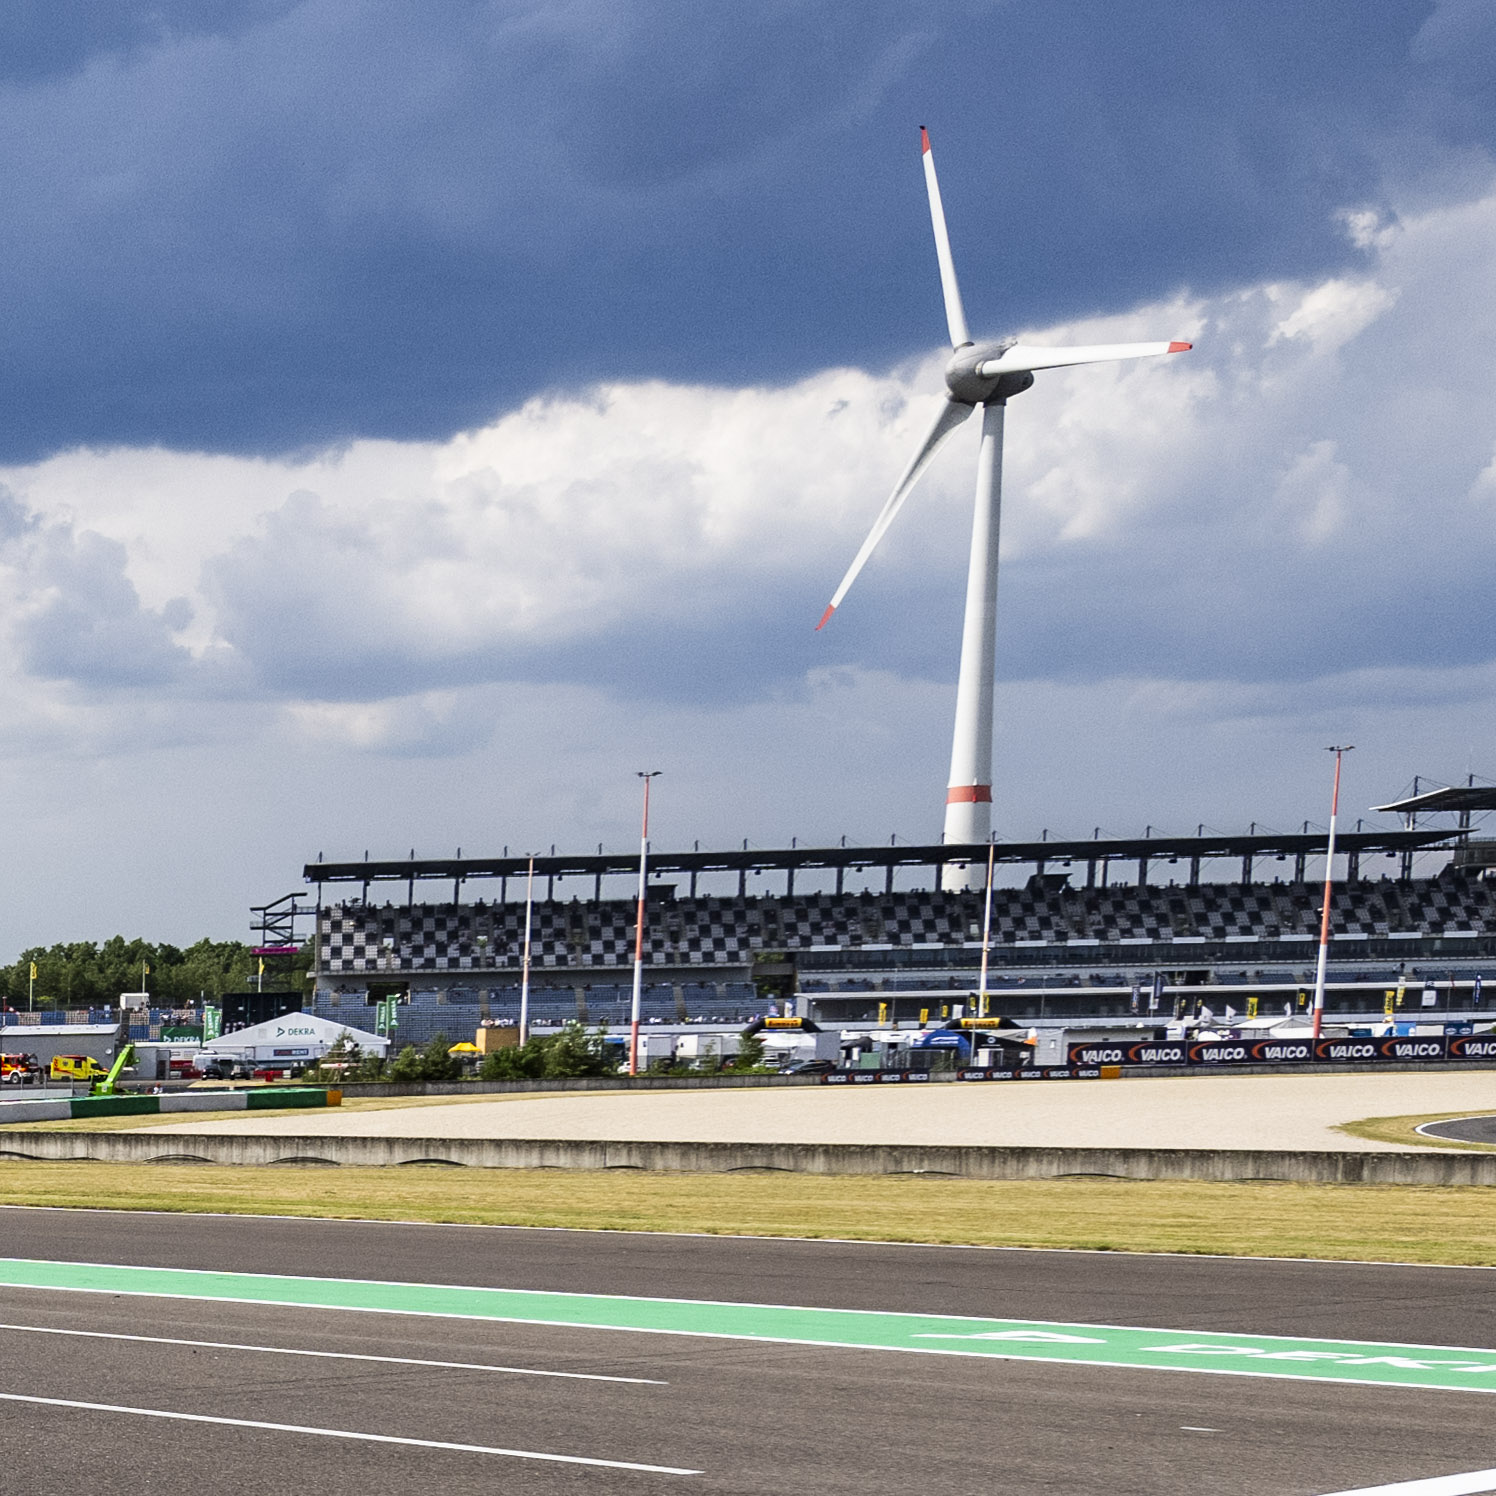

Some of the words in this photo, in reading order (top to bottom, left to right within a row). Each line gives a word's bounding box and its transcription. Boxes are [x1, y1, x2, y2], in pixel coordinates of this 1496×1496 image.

[1082, 1049, 1122, 1062] VAICO
[1141, 1048, 1180, 1060] VAICO
[1202, 1047, 1245, 1060] VAICO
[1264, 1046, 1307, 1059] VAICO
[1329, 1045, 1374, 1057] VAICO
[1395, 1044, 1440, 1056] VAICO
